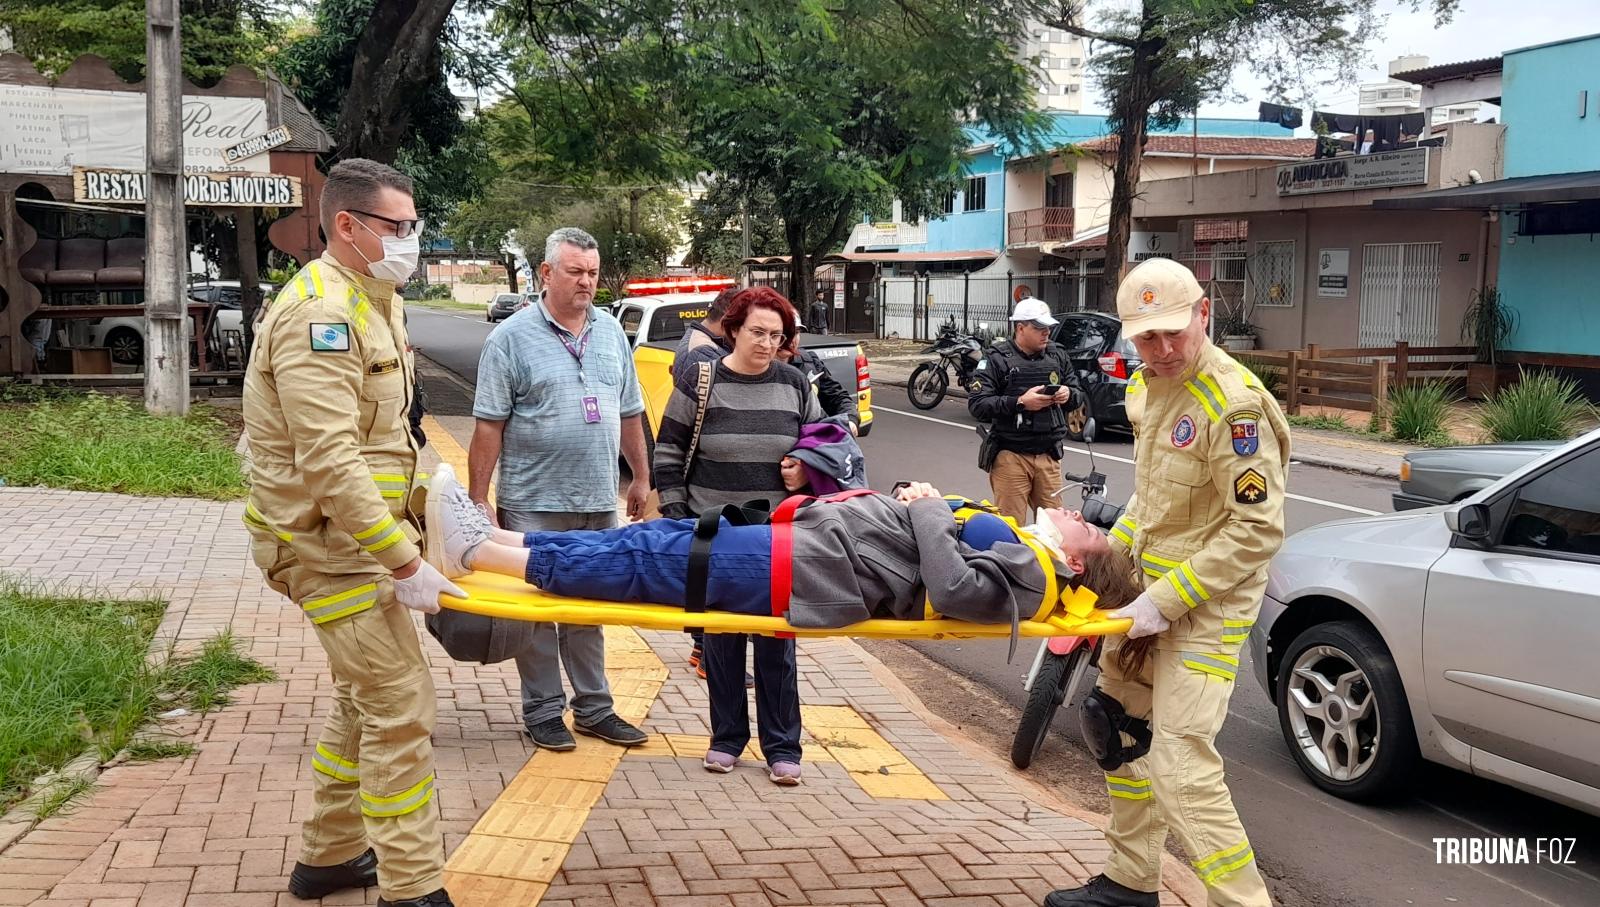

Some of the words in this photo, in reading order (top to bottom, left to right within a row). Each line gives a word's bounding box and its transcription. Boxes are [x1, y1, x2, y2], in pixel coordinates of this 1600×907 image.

[9, 113, 57, 121] PINTURAS
[182, 102, 262, 138] Real
[521, 262, 534, 293] HOTE
[678, 309, 708, 319] POLÍCI
